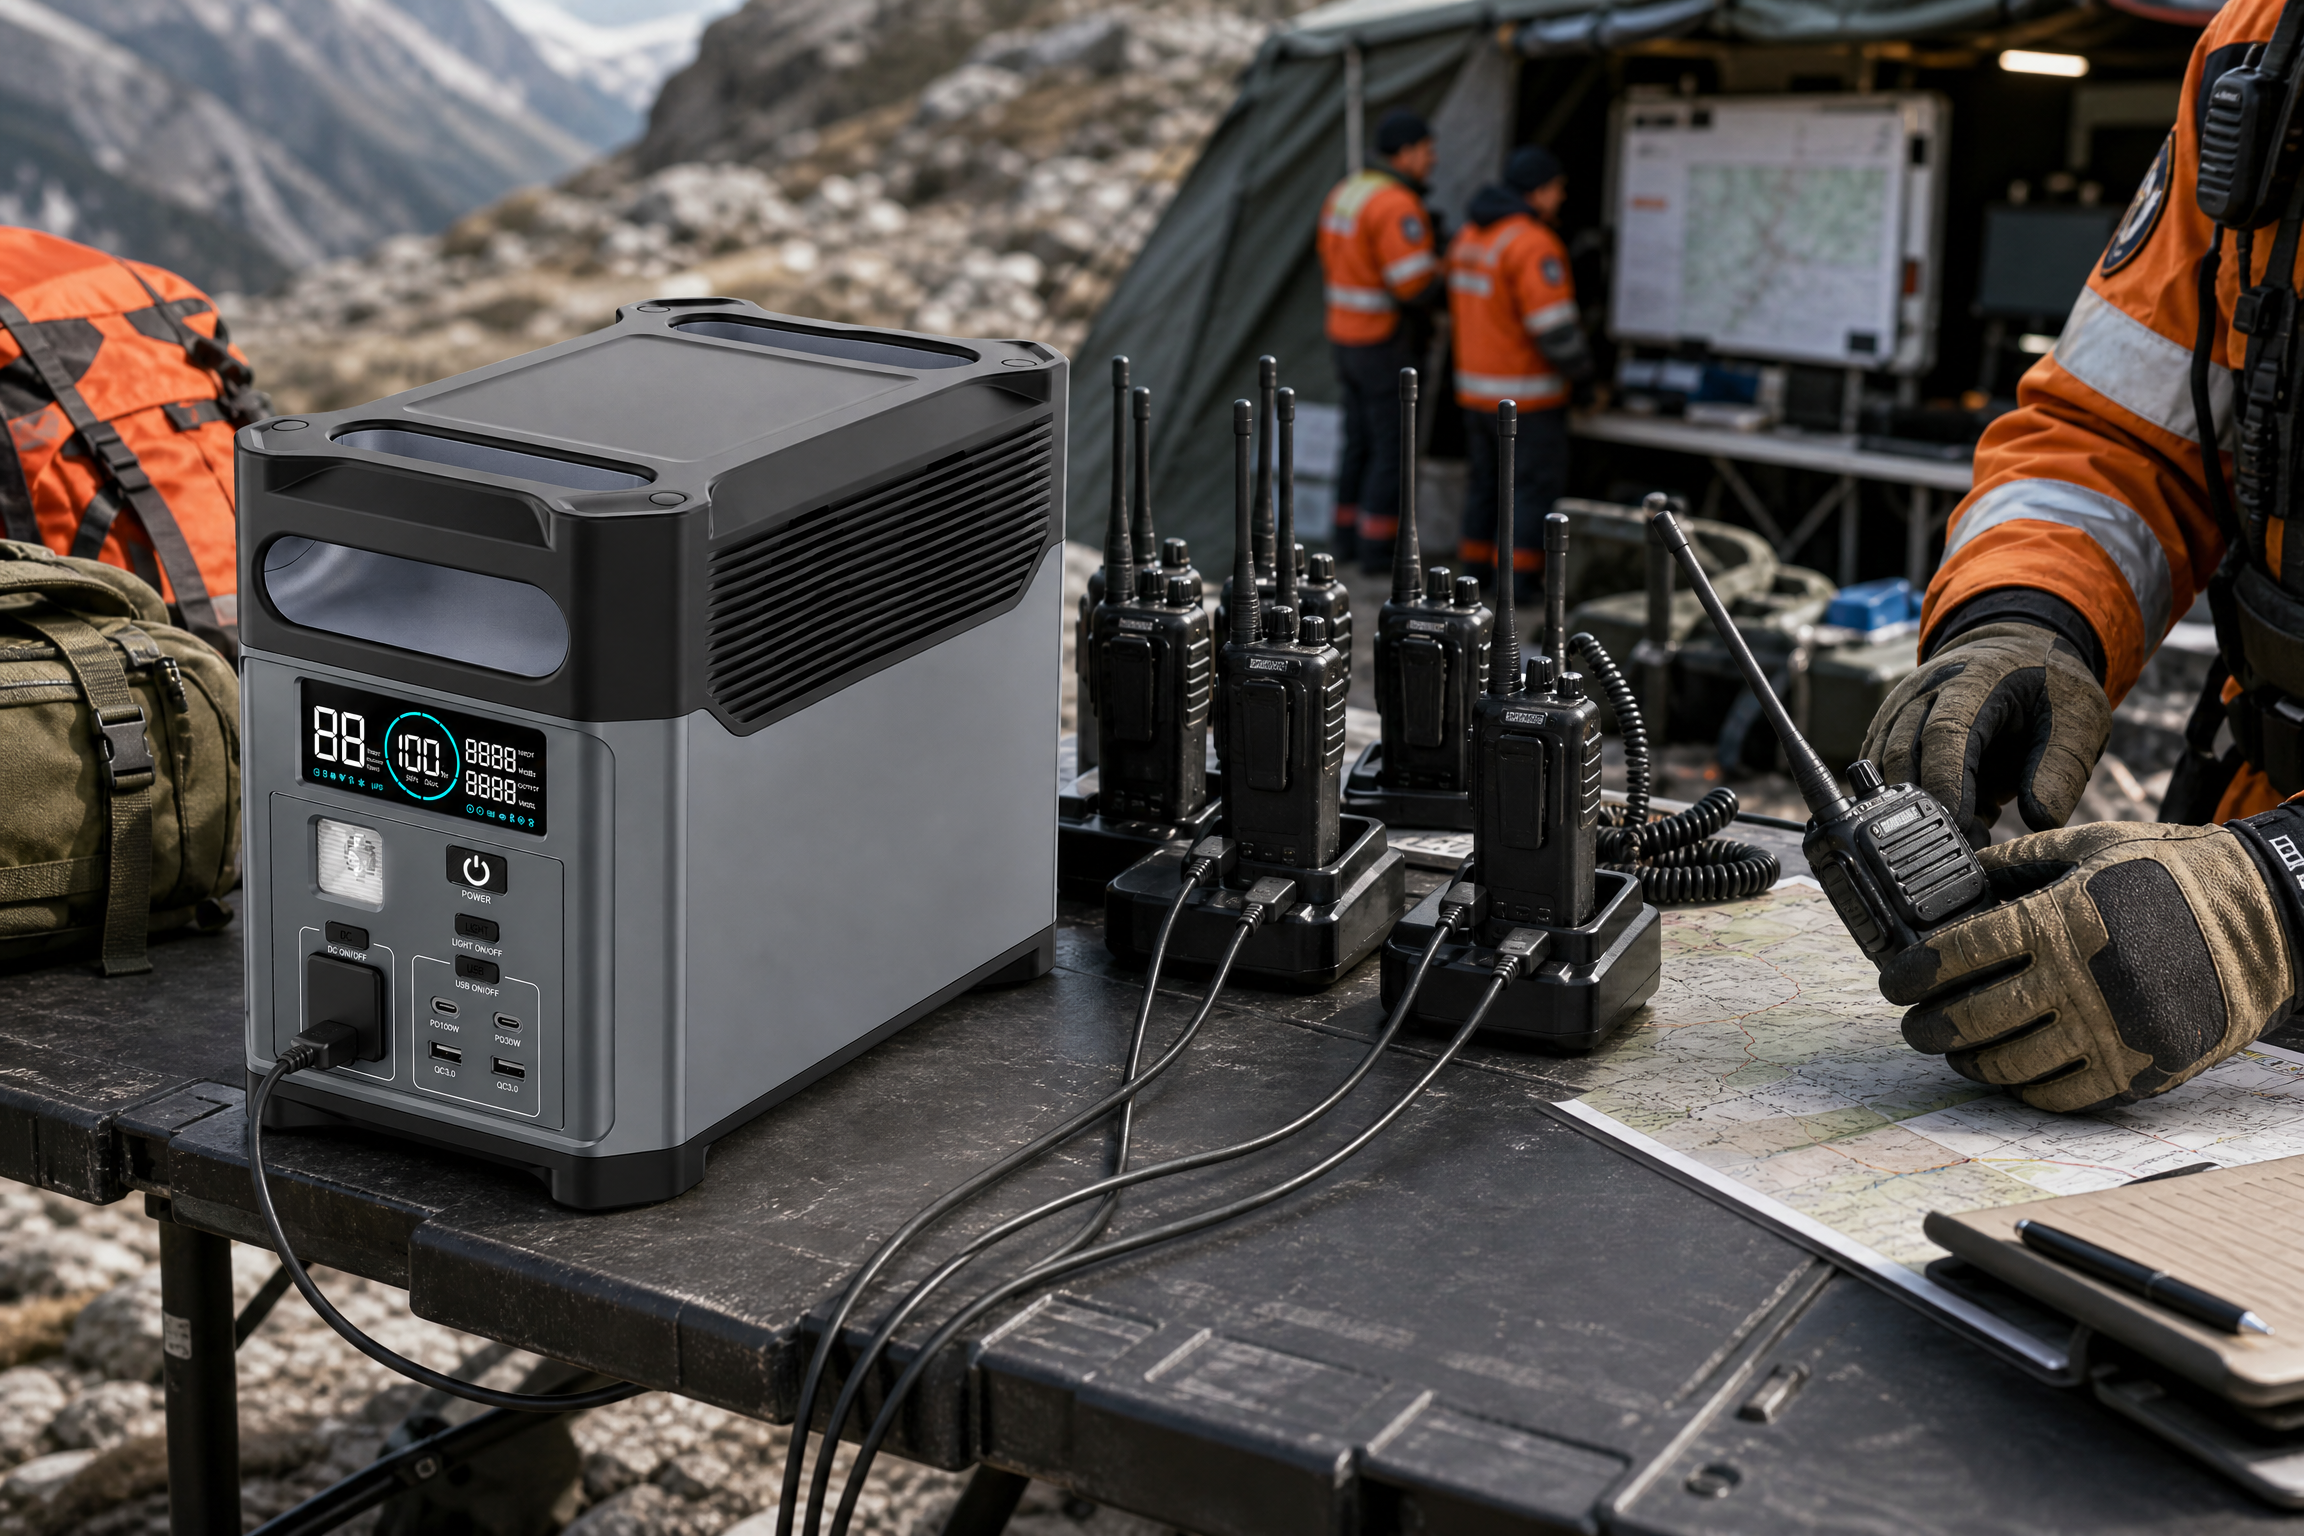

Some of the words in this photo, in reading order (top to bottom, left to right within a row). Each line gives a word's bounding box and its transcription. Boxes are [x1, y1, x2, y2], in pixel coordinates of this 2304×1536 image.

[314, 705, 365, 768] 88
[398, 734, 440, 777] 100
[465, 738, 516, 773] 8888
[465, 770, 516, 805] 8888
[461, 889, 491, 904] POWER
[340, 930, 352, 941] DC
[327, 945, 338, 954] DC
[339, 948, 367, 961] ON/OFF
[474, 944, 503, 957] ON/OFF
[466, 963, 484, 976] USB
[455, 979, 470, 990] USB
[471, 983, 500, 997] ON/OFF
[429, 1019, 459, 1033] PD100W
[494, 1034, 521, 1047] PD30W
[434, 1065, 456, 1078] QC3.0
[496, 1081, 519, 1093] QC3.0
